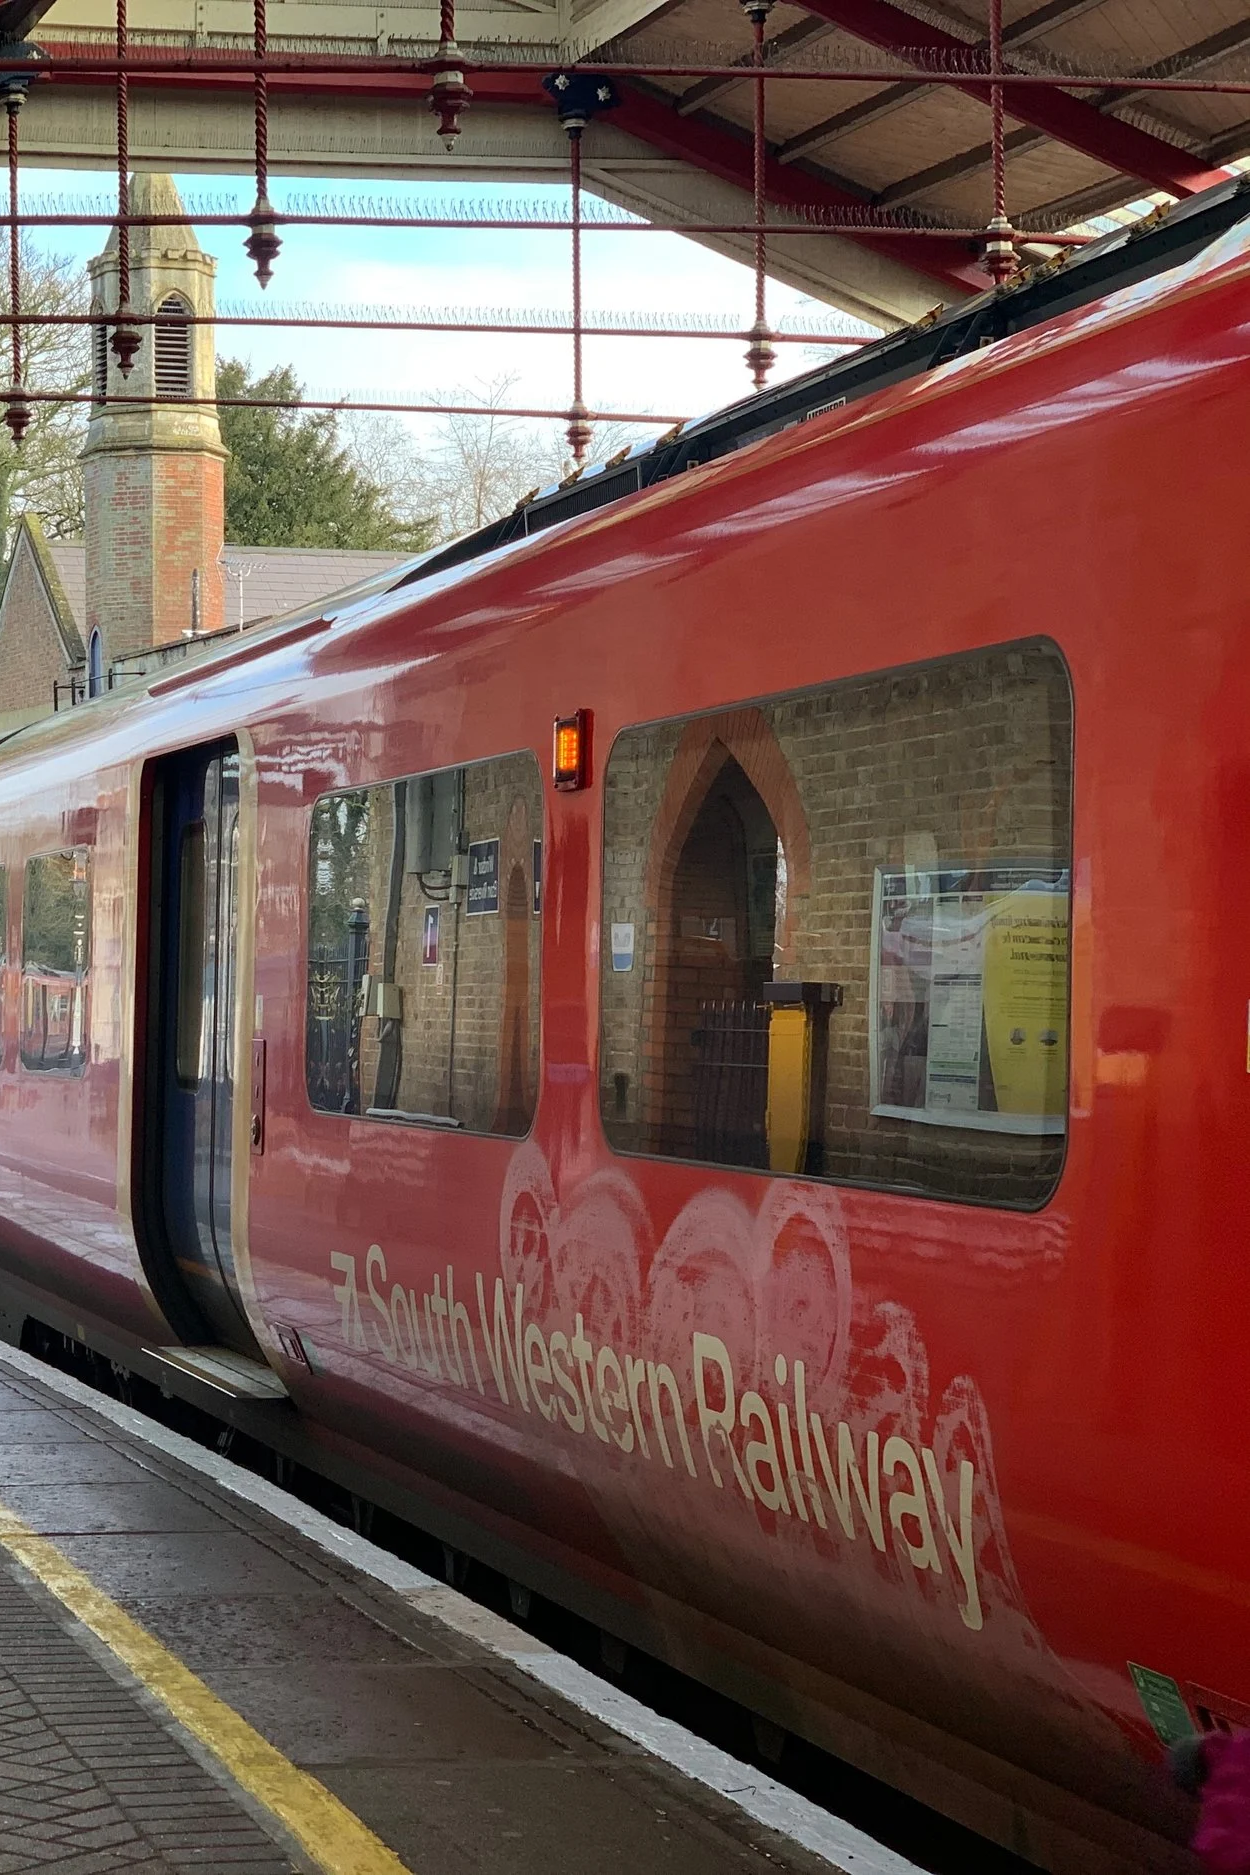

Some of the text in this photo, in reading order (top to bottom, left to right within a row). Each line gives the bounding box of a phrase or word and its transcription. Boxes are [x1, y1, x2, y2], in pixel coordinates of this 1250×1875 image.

[364, 1243, 984, 1631] South Western Railway
